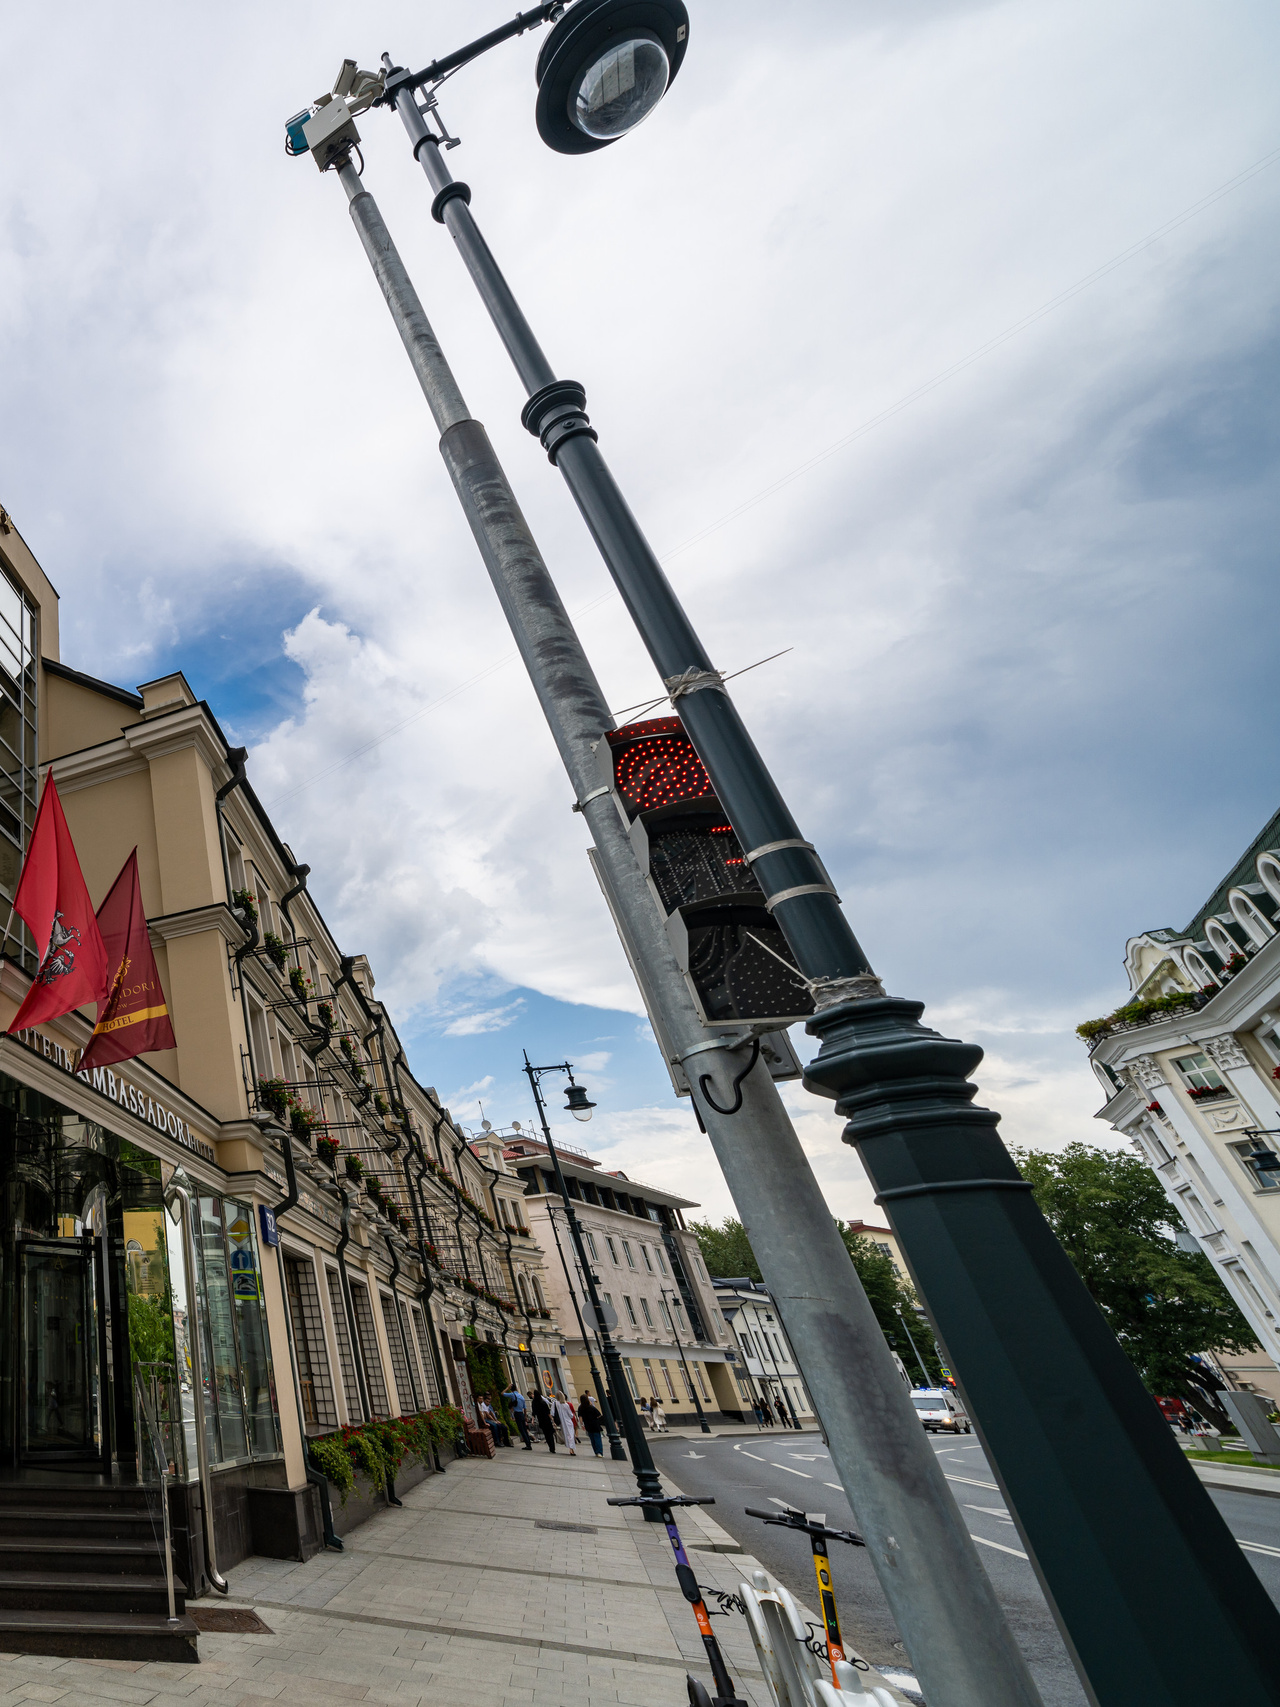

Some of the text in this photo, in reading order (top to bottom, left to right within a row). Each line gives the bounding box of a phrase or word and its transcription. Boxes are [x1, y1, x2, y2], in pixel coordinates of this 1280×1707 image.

[102, 1016, 134, 1031] HOTEL
[266, 1212, 276, 1233] 32
[458, 1365, 473, 1420] ПРОДУКТ
